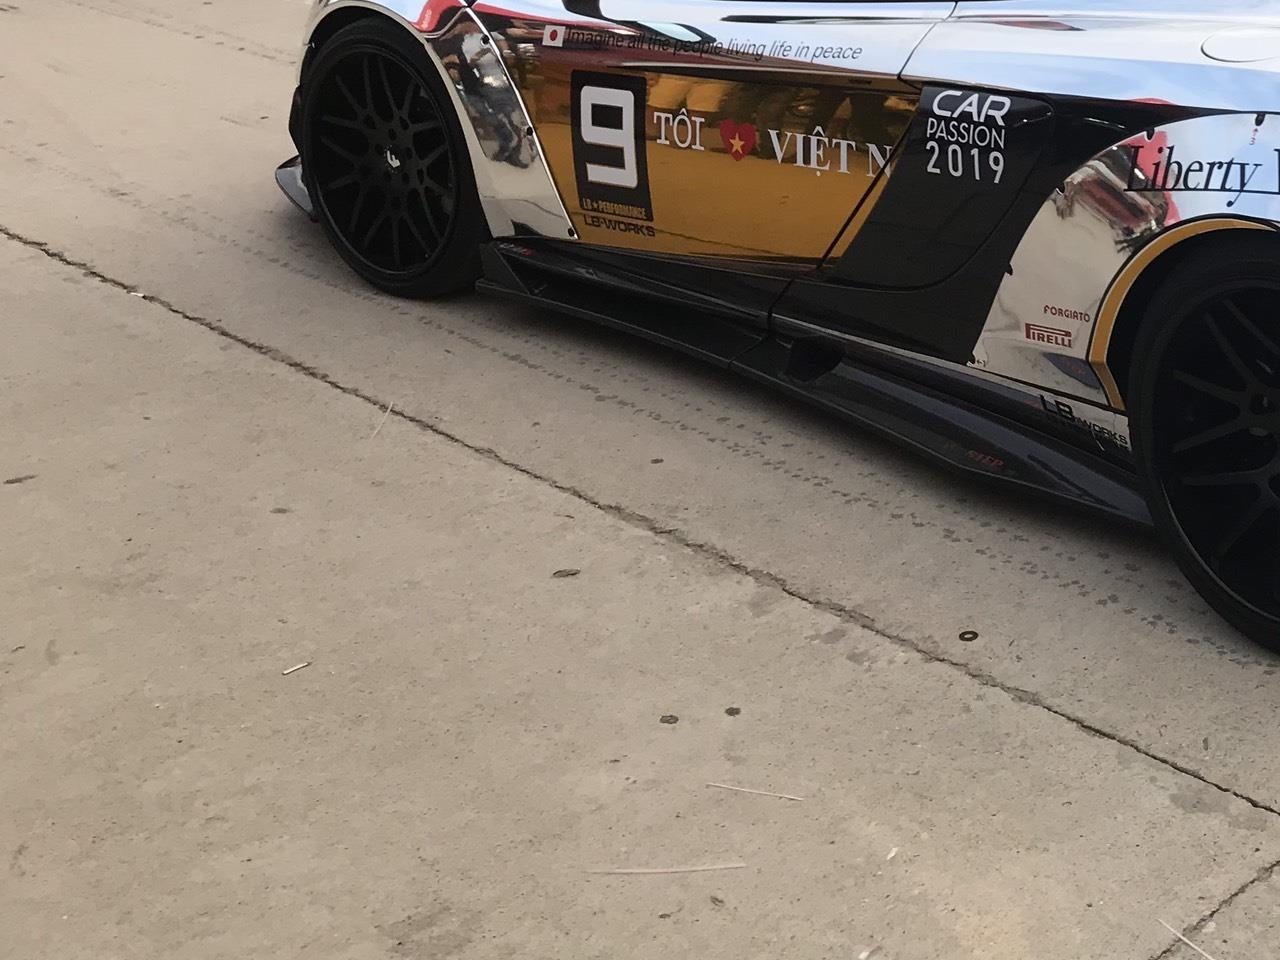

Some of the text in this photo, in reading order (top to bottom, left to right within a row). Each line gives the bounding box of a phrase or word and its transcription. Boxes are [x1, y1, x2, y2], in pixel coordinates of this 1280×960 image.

[726, 38, 766, 61] living
[768, 39, 793, 57] life
[795, 41, 811, 58] in
[811, 43, 864, 63] peace
[931, 89, 1011, 127] CAR
[580, 85, 639, 189] 9
[653, 107, 707, 151] TÔI
[767, 125, 857, 180] VIỆT
[926, 117, 1006, 150] PASSION
[926, 141, 1005, 184] 2019
[1124, 143, 1263, 208] Liberty
[1043, 304, 1091, 324] FORGIATO
[1025, 322, 1073, 349] PIRELLI
